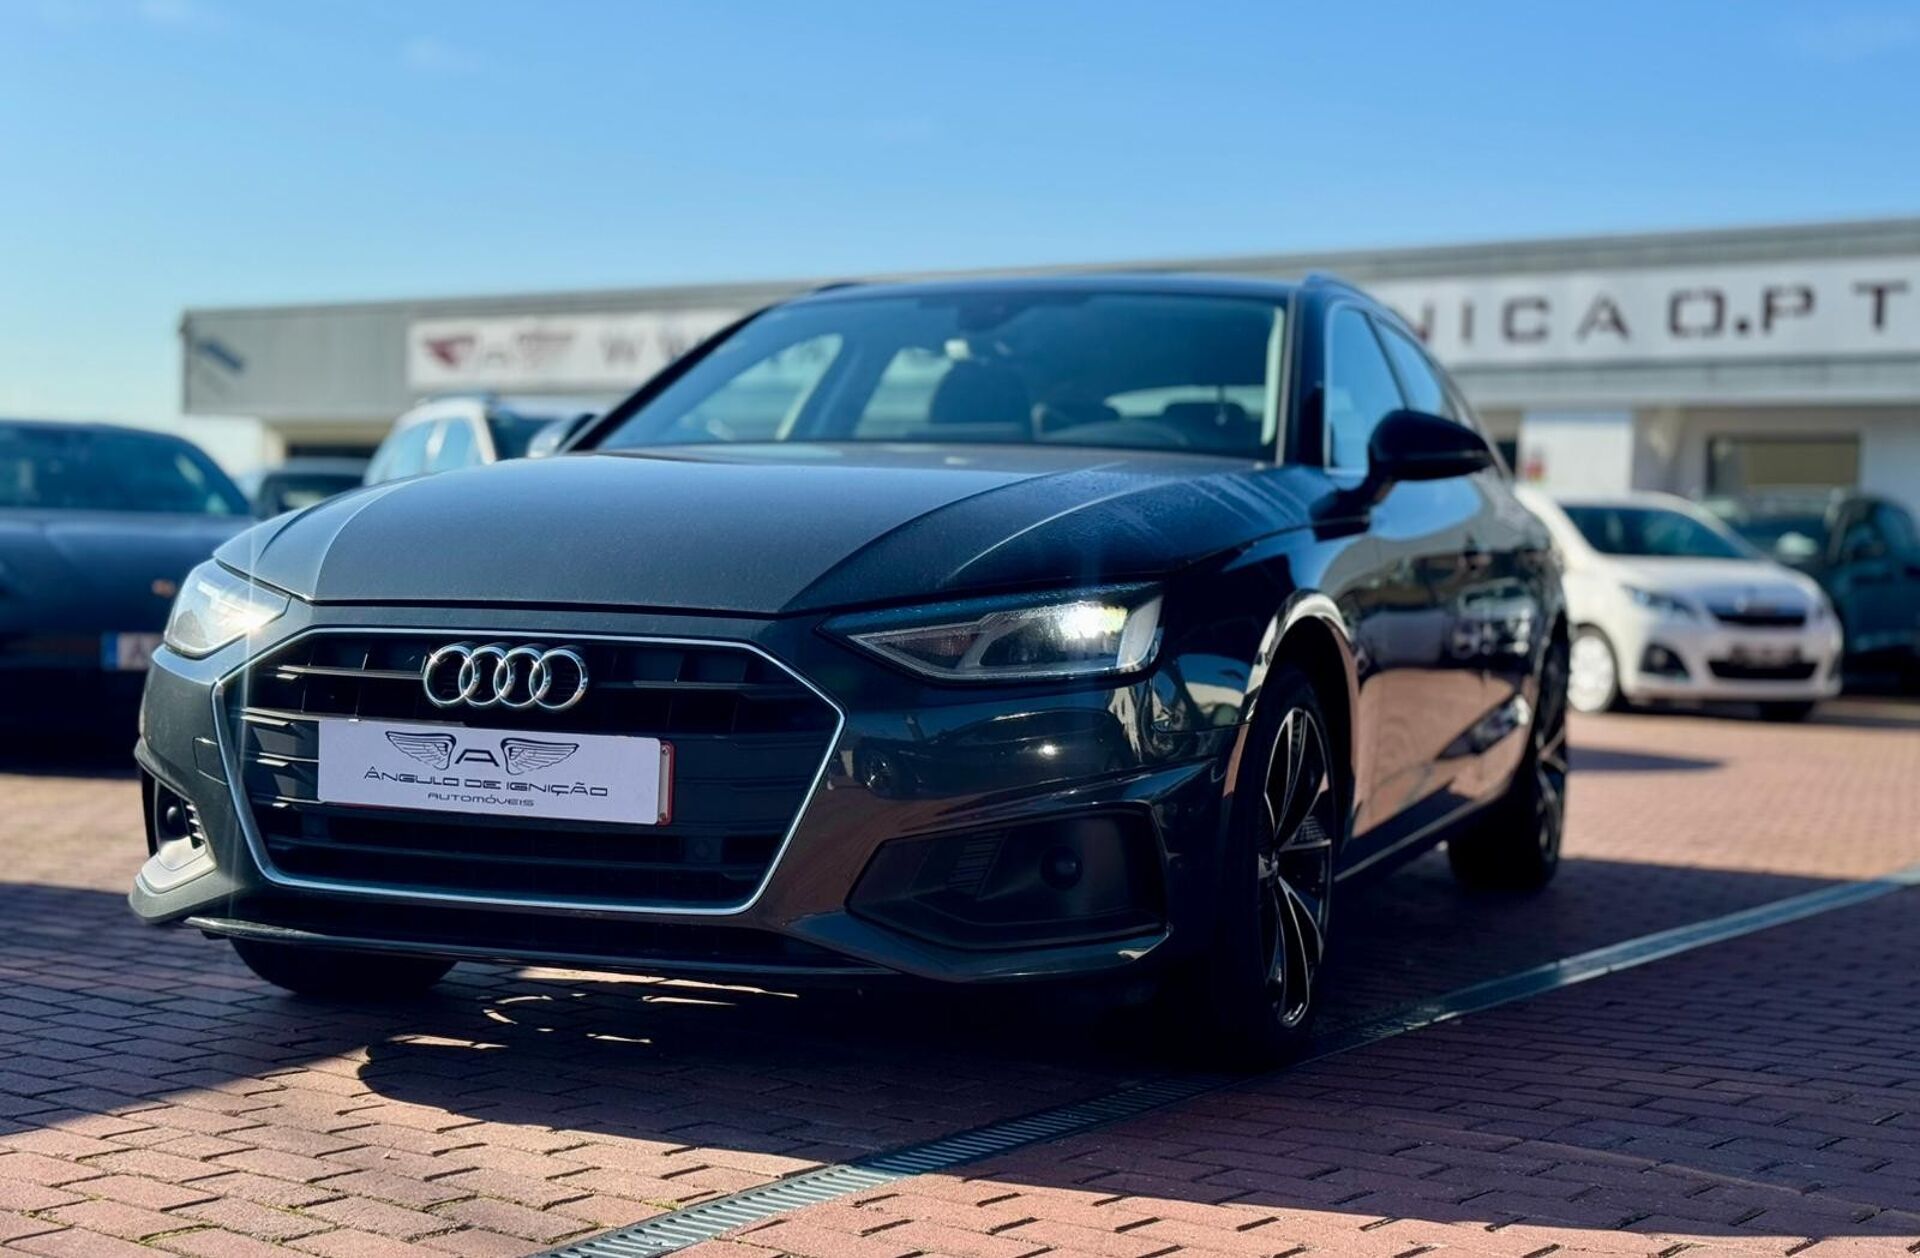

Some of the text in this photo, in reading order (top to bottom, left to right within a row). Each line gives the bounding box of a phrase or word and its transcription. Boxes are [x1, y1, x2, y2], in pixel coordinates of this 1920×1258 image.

[455, 748, 500, 767] A
[364, 766, 608, 797] ÂNGULO DE IGNIÇÃO
[428, 792, 534, 807] AUTOMÓVEIS
